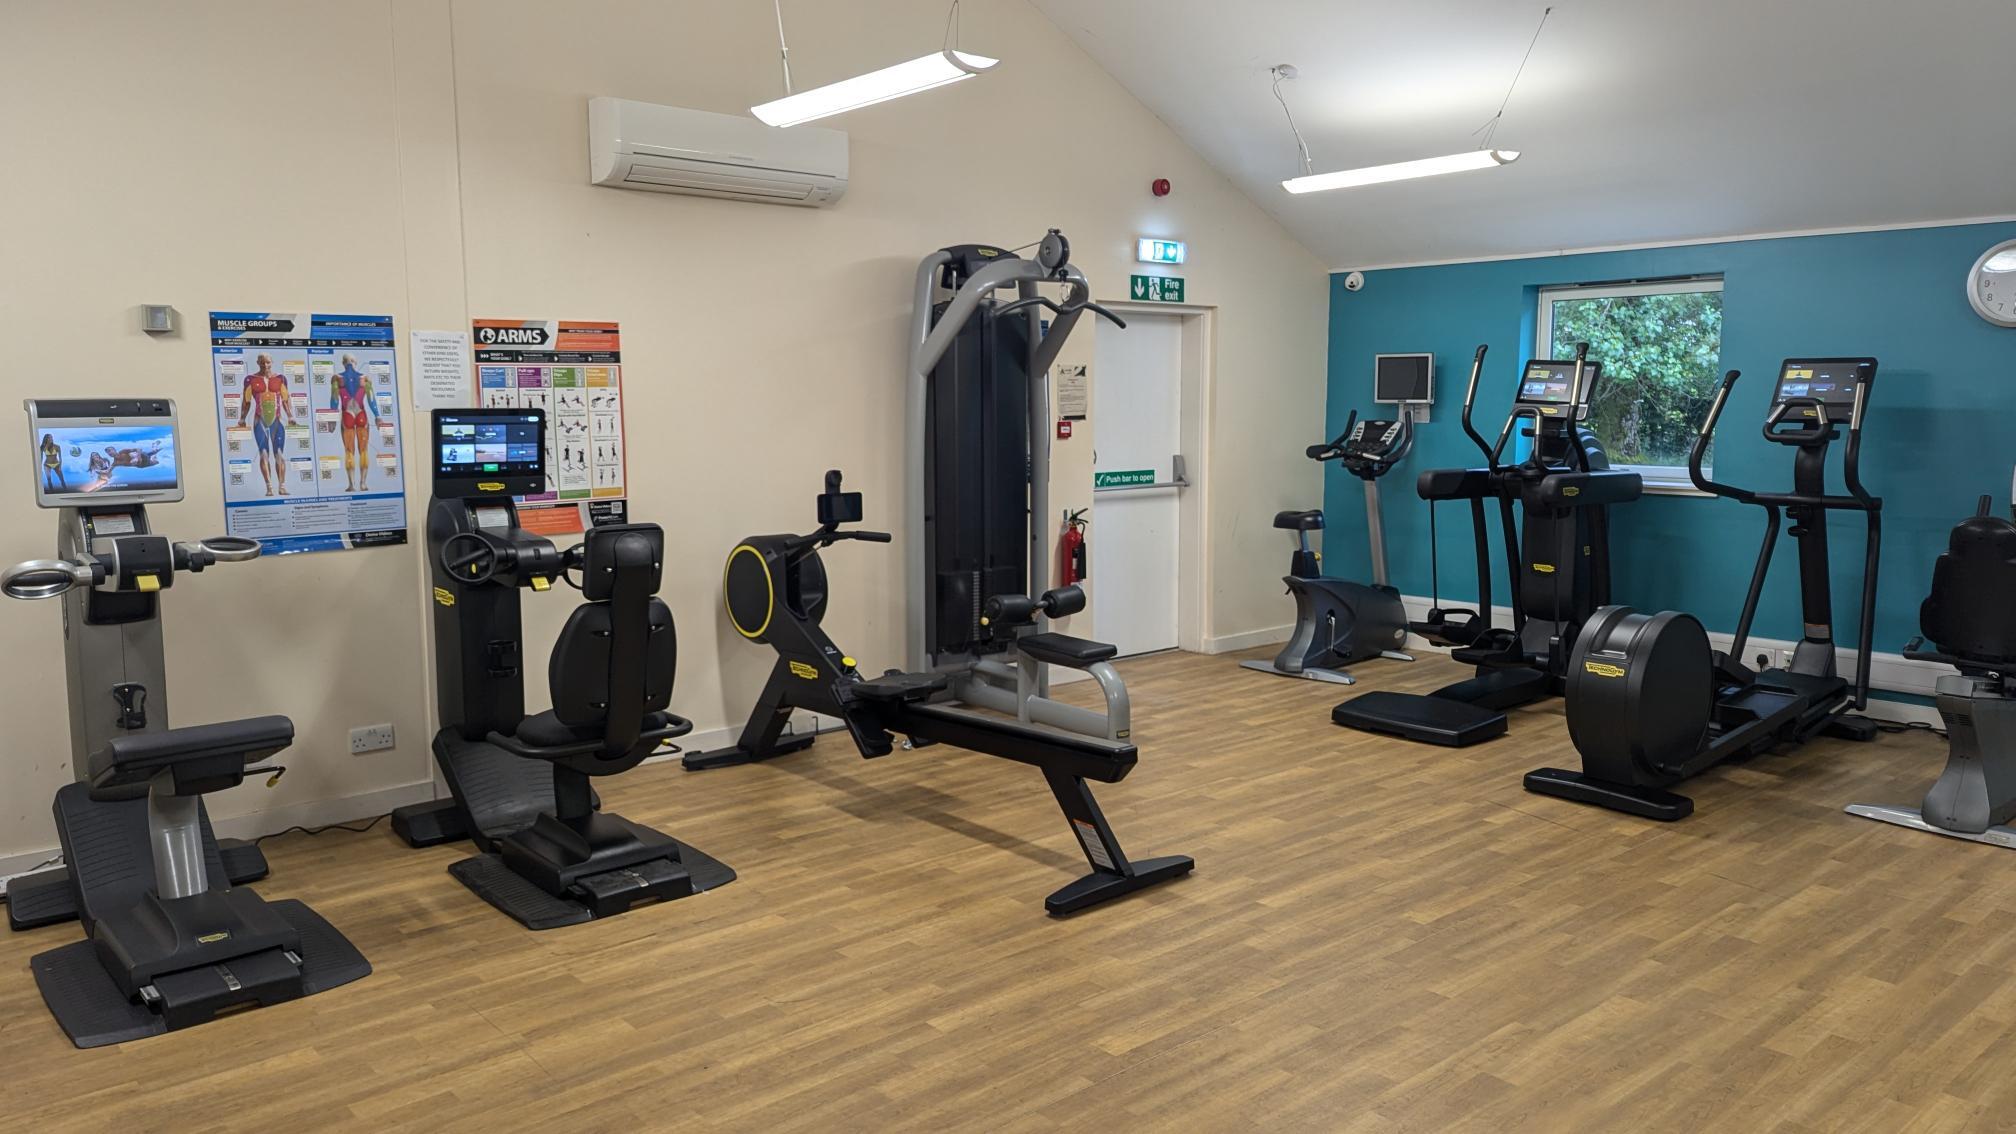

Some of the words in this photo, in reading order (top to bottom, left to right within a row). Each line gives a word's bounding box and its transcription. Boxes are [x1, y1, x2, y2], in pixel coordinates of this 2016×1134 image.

[1164, 278, 1180, 290] Fire
[1984, 279, 1991, 288] 9
[1164, 290, 1178, 300] exit
[1987, 293, 1993, 302] 8
[1998, 302, 2004, 312] 7
[217, 319, 247, 327] MUSCLE
[247, 320, 278, 328] GROUPS
[497, 329, 542, 344] ARMS
[1106, 474, 1121, 483] Push
[1121, 474, 1132, 483] bar
[1132, 474, 1139, 482] to
[1139, 474, 1154, 483] open
